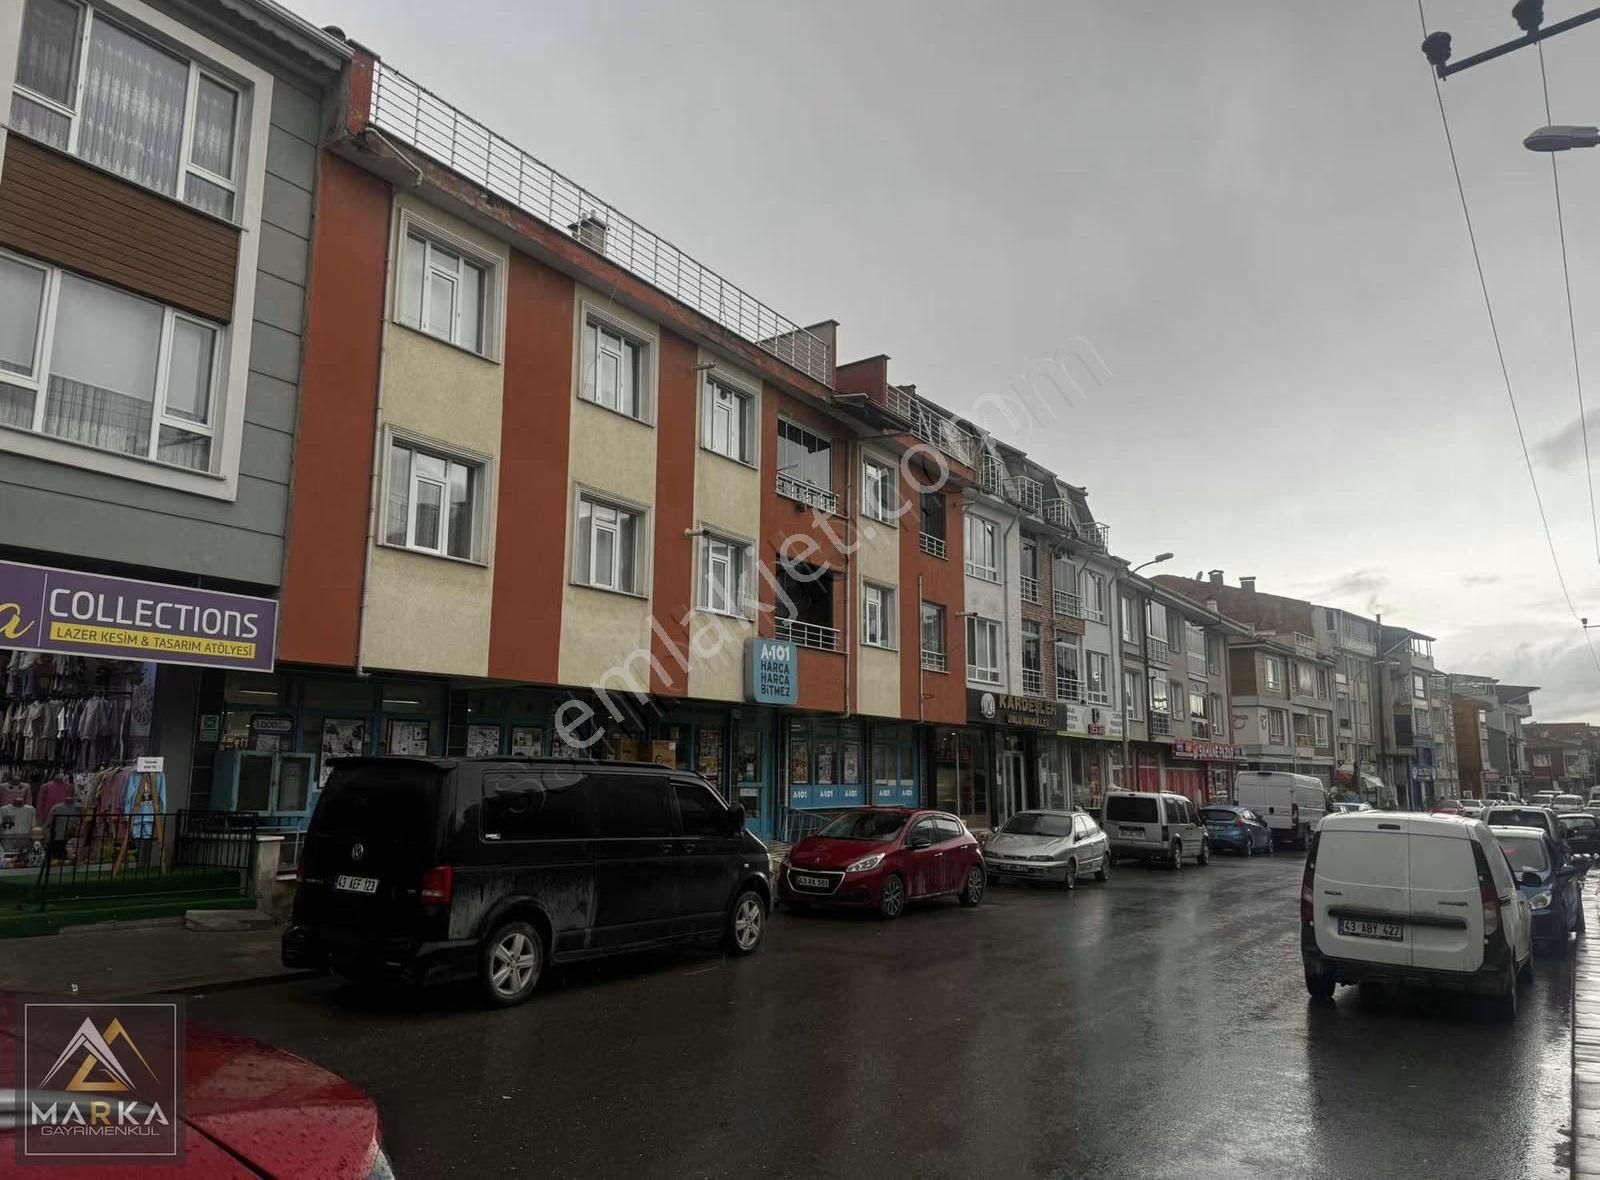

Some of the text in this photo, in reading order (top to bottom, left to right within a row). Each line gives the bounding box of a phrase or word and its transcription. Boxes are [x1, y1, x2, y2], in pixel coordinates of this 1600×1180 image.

[49, 588, 258, 638] COLLECTIONS
[57, 626, 253, 657] LAZER KESİM & TASARIM ATÖLYESİ
[760, 660, 790, 674] HARCA
[760, 671, 790, 686] HARCA
[1344, 920, 1400, 937] 43 ABY 427
